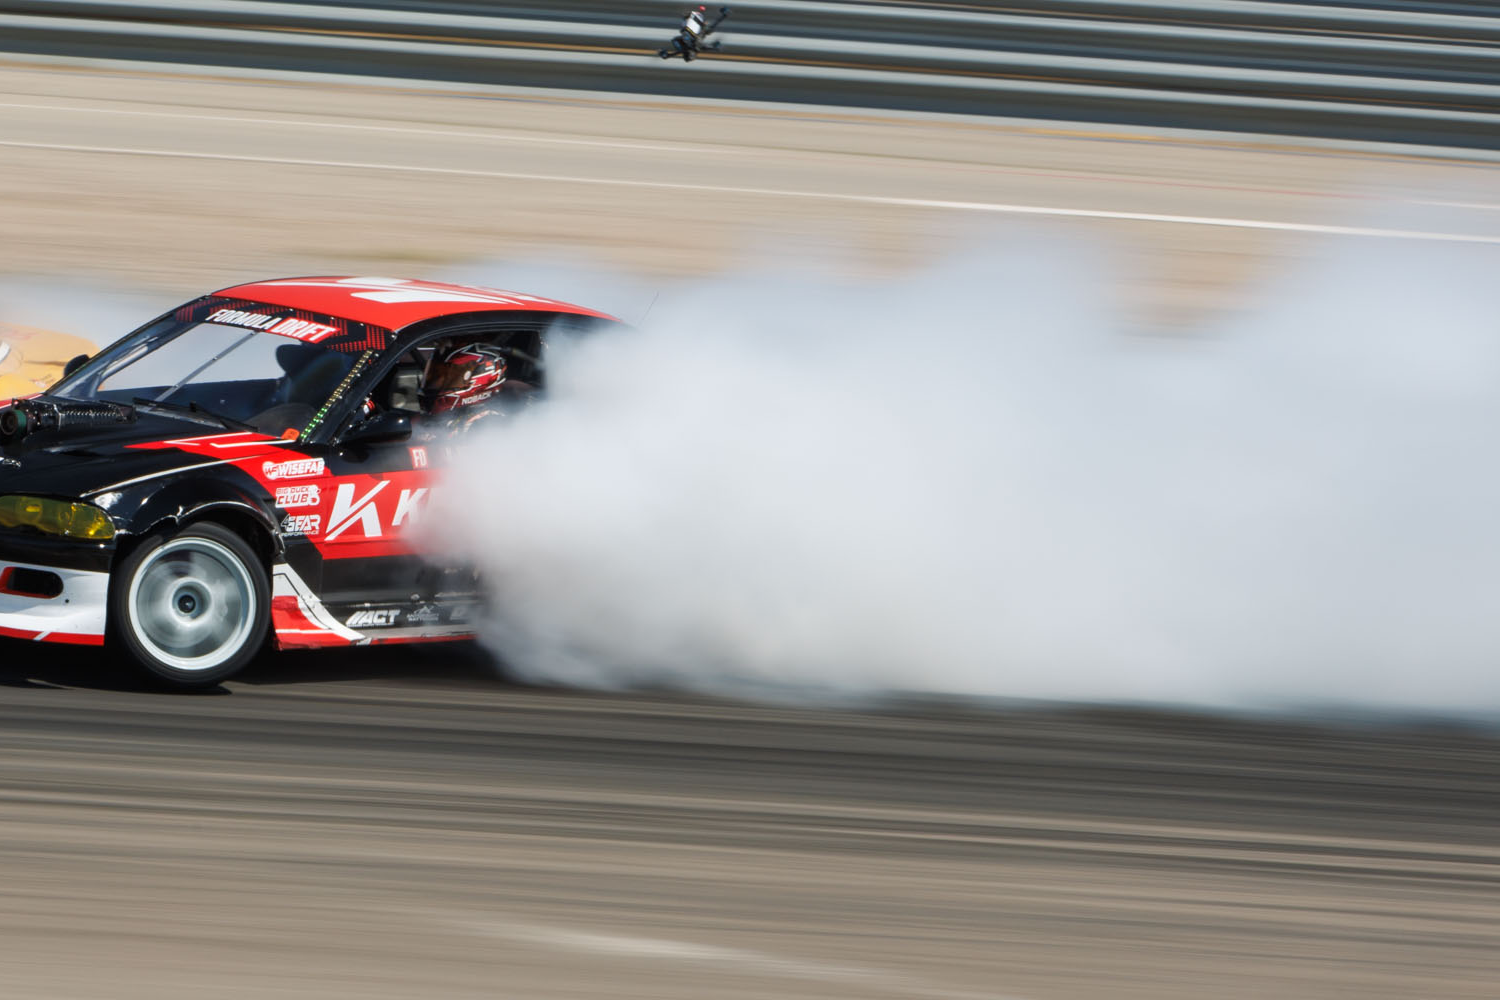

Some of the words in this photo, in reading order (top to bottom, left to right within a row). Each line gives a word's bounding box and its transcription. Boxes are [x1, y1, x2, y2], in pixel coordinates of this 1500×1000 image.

[205, 309, 282, 330] FORMULA
[270, 318, 337, 342] DRIFT
[412, 448, 427, 467] FD
[278, 459, 324, 477] WISEFAB
[278, 494, 308, 505] CLUB
